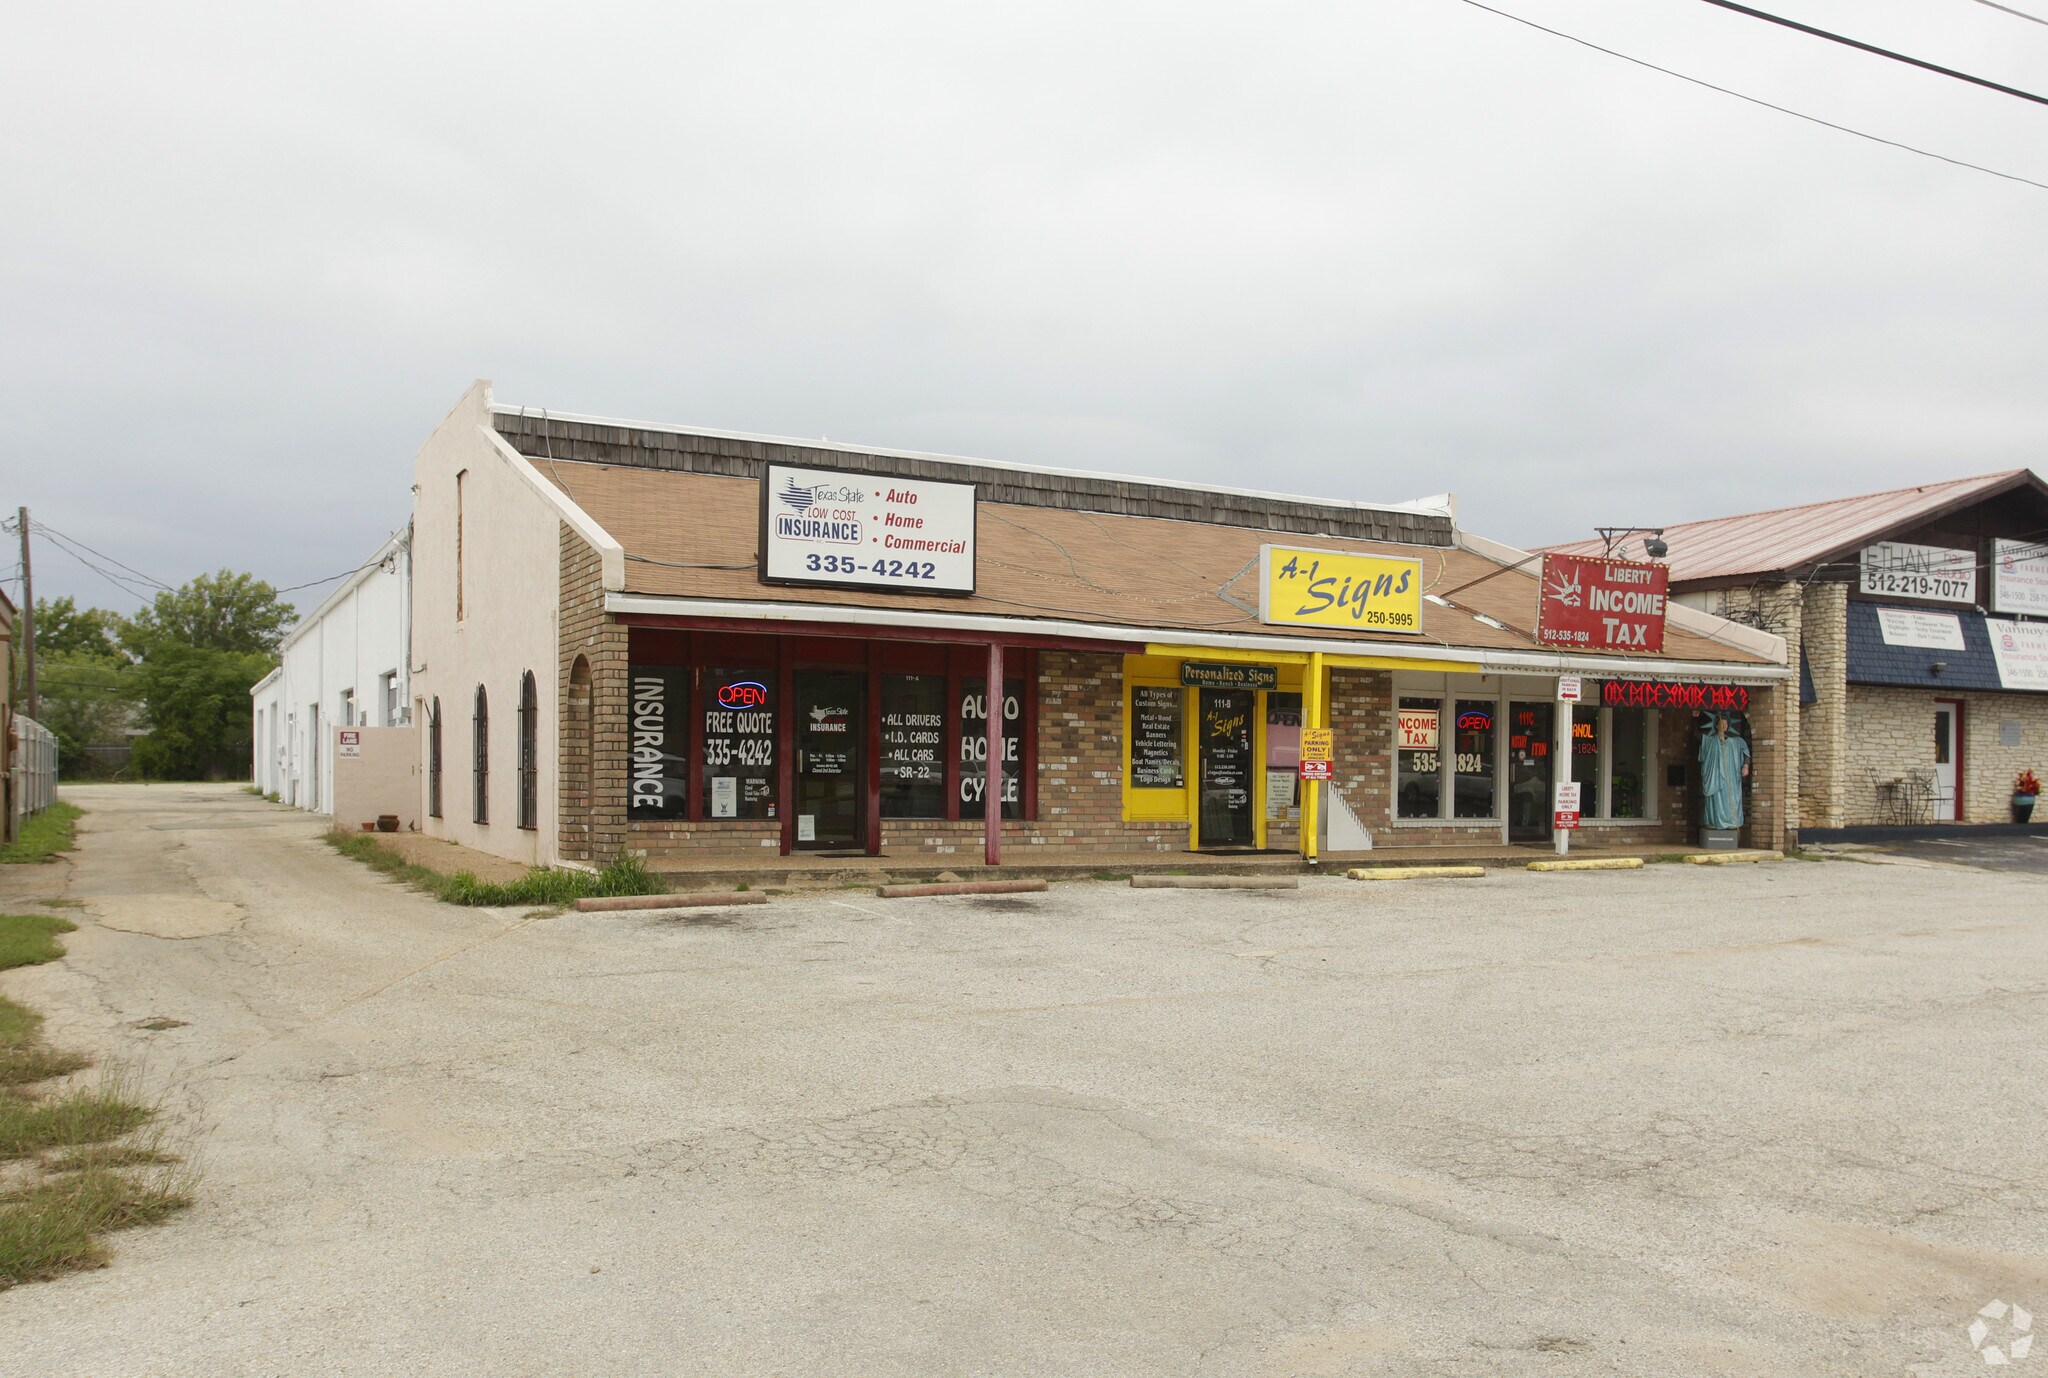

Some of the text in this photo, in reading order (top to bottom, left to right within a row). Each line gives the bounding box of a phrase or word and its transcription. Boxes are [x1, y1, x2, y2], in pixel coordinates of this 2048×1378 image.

[802, 484, 865, 503] Texas State
[886, 488, 918, 505] Auto
[808, 508, 856, 521] LOW COST
[885, 513, 924, 529] Home
[779, 518, 858, 541] INSURANCE
[884, 534, 966, 554] Commercial
[1866, 542, 1930, 575] ETHAN
[1943, 552, 1963, 564] hair
[2001, 544, 2048, 559] Vannoy
[806, 553, 936, 580] 335-4242
[1279, 556, 1319, 581] A-1
[2021, 564, 2048, 573] FARME
[1605, 564, 1652, 584] LIBERTY
[1936, 567, 1972, 581] studio
[1999, 574, 2048, 585] Insurance Sto
[1867, 573, 1968, 598] 512-219-7077
[1295, 569, 1411, 619] Signs
[1589, 585, 1664, 616] INCOME
[2000, 590, 2025, 600] 346-1500
[1544, 629, 1590, 642] 512-535-1824
[1602, 617, 1648, 646] TAX
[2021, 641, 2048, 650] FARME
[1184, 665, 1275, 685] Personalized Signs
[718, 686, 765, 705] OPEN
[1149, 690, 1166, 700] Types
[961, 694, 1019, 720] AUO
[1214, 699, 1231, 708] 111-B
[887, 714, 941, 727] ALL DRIVERS
[1206, 710, 1218, 720] A-1
[1519, 712, 1535, 725] 111C
[706, 712, 772, 734] FREE QUOTE
[810, 723, 846, 732] INSURANCE
[1211, 714, 1244, 736] Signs
[1398, 718, 1436, 730] NCOME
[1458, 716, 1491, 729] OPEN
[891, 731, 939, 744] I.D. CARDS
[1405, 730, 1428, 745] TAX
[1572, 723, 1594, 738] ANOL
[633, 677, 665, 808] INSURANCE
[1153, 741, 1177, 749] Lettering
[1531, 742, 1547, 756] ITIN
[707, 739, 772, 766] 335-4242
[894, 749, 934, 761] ALL CARS
[1143, 749, 1168, 757] Magnetics
[900, 766, 930, 779] SR-22
[1154, 776, 1171, 784] Design
